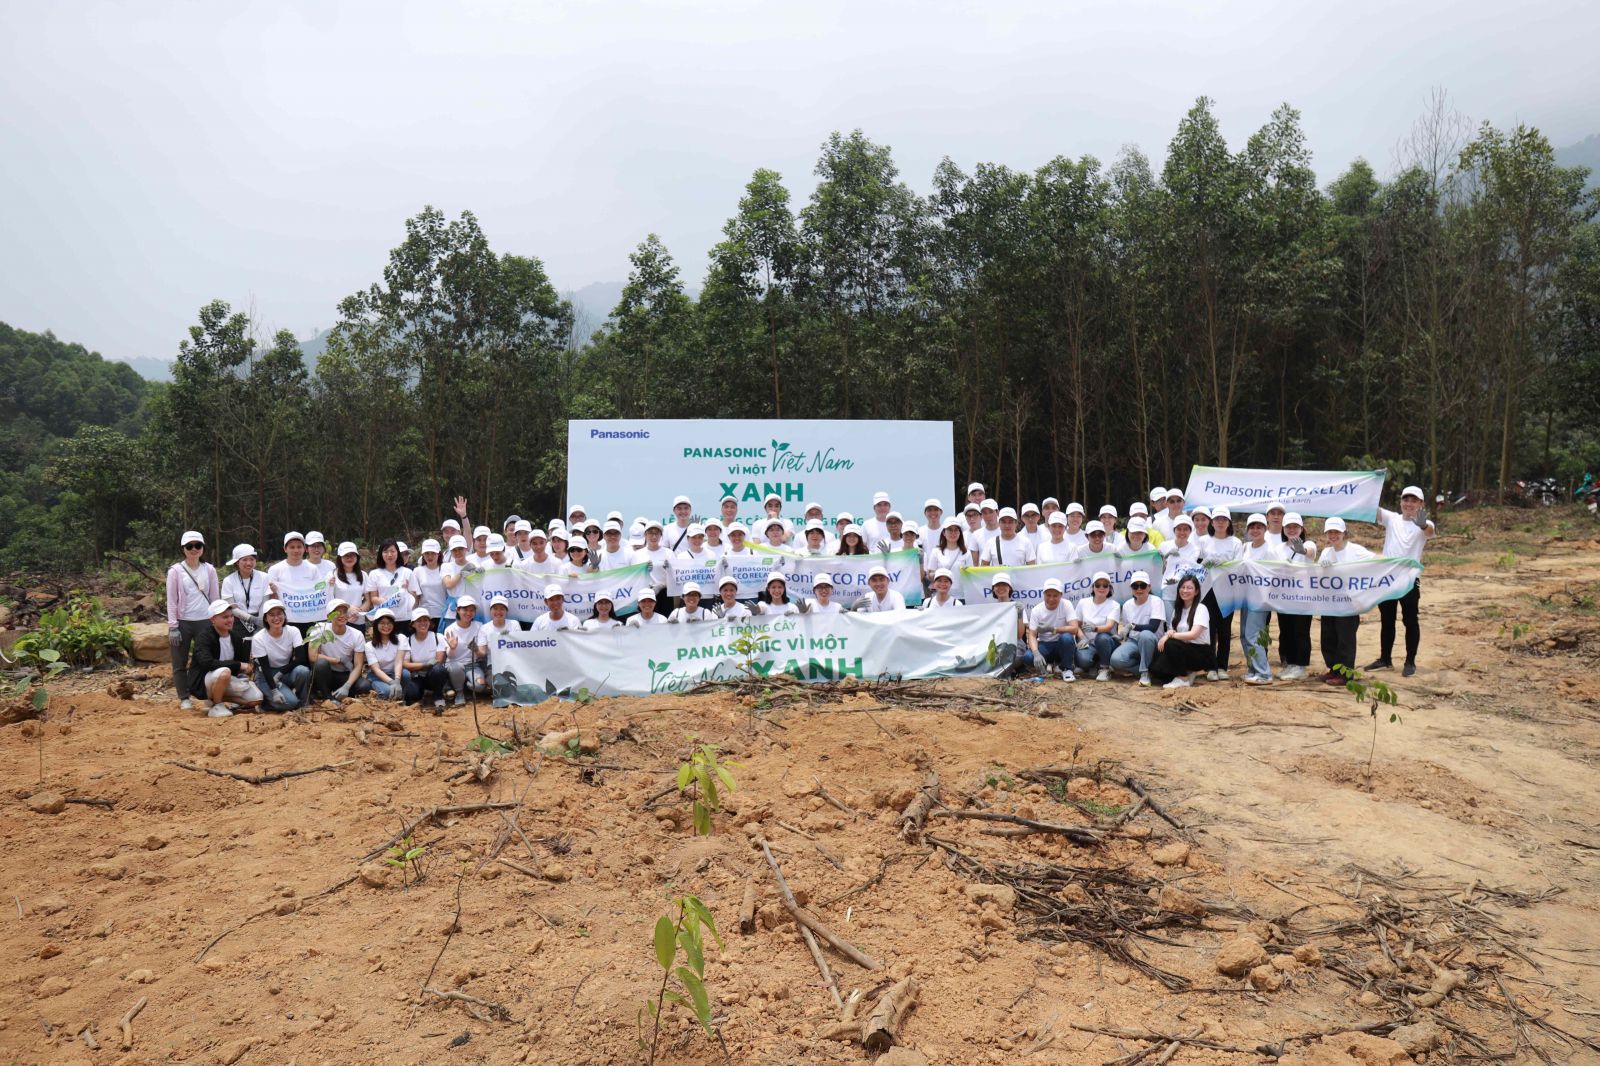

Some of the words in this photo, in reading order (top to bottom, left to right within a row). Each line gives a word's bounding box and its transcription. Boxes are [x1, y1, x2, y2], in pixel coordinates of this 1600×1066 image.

[590, 429, 650, 439] Panasonic
[683, 447, 767, 458] PANASONIC
[772, 448, 806, 473] Việt
[806, 447, 855, 473] Nam
[728, 464, 740, 475] VÌ
[742, 463, 767, 476] MỘT
[719, 482, 804, 502] XANH
[1204, 480, 1274, 499] Panasonic
[790, 516, 828, 526] TRG
[826, 572, 853, 586] CO
[1064, 576, 1092, 594] ECO
[1228, 573, 1304, 588] Panasonic
[1310, 576, 1343, 590] ECO
[282, 590, 327, 602] Panasonic
[588, 586, 633, 603] RAY
[1268, 592, 1279, 600] for
[1281, 594, 1330, 602] Sustainable
[773, 620, 797, 633] CÂY
[497, 635, 557, 650] Panasonic
[677, 638, 782, 661] PANASNIC
[786, 633, 805, 651] VÌ
[809, 632, 848, 654] MỘT
[752, 656, 864, 681] XANH
